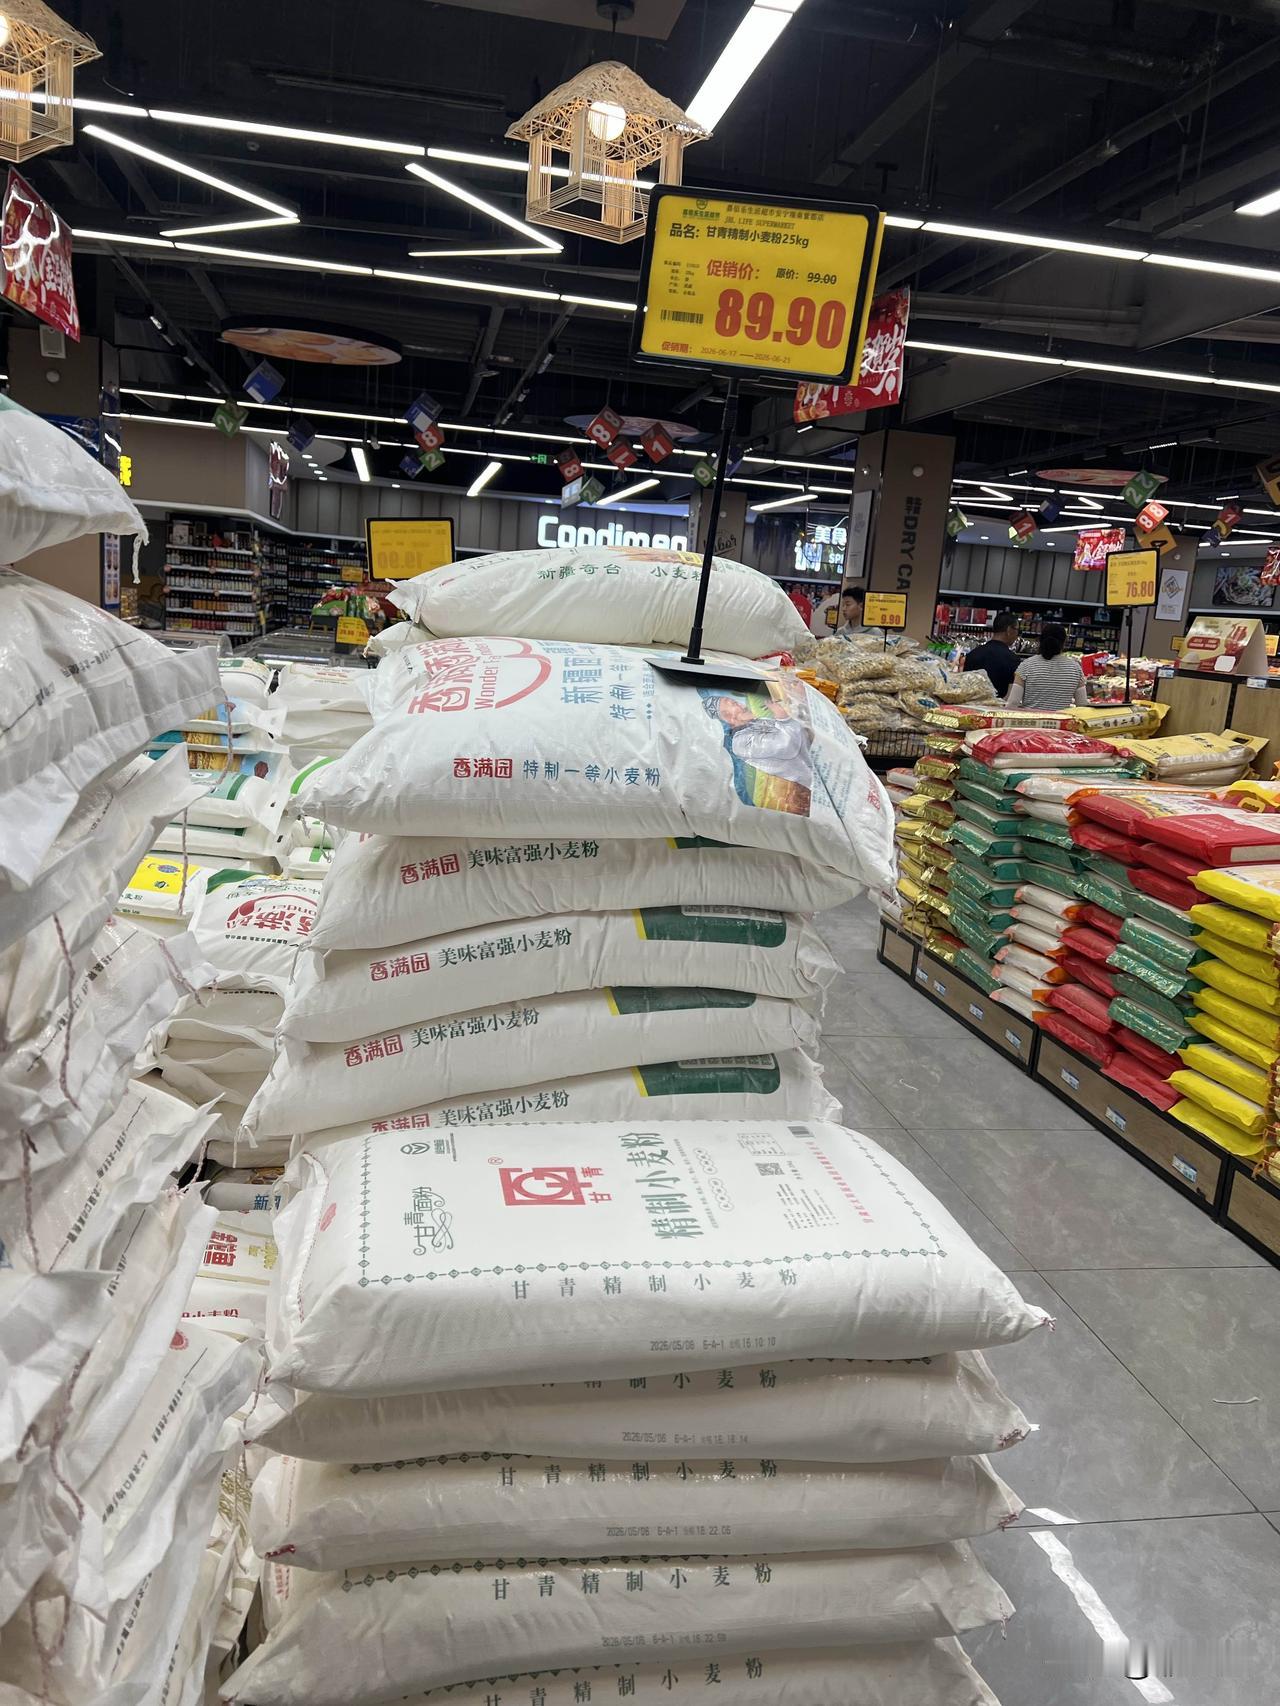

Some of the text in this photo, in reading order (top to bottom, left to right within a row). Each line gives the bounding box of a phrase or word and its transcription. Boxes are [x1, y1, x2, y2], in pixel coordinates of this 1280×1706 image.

[706, 225, 809, 248] 甘青精制小麦粉25kg
[807, 271, 837, 285] 99.00
[715, 288, 846, 349] 89.90
[422, 431, 438, 447] 8
[592, 423, 611, 442] 8
[652, 440, 667, 456] 1
[565, 464, 580, 478] 8
[1125, 487, 1142, 501] 2
[1138, 515, 1154, 529] 8
[899, 515, 919, 560] DRY
[1126, 580, 1154, 598] 76.80
[880, 614, 901, 625] 9.90
[453, 757, 661, 787] 香满园 特制一等小麦粉
[400, 839, 600, 885] 香满园 美味富强小麦粉
[369, 928, 573, 981] 香满园 美味富强小麦粉
[344, 1007, 540, 1067] 香满园 美味富强小麦粉
[439, 1089, 570, 1127] 美味富强小麦粉
[618, 1132, 704, 1240] 精制小麦粉
[512, 1268, 797, 1300] 甘青精制小麦粉
[499, 1458, 778, 1486] 甘青精制小麦粉
[492, 1562, 772, 1601] 甘青精制小麦粉
[485, 1657, 763, 1706] 甘青精制小麦粉
